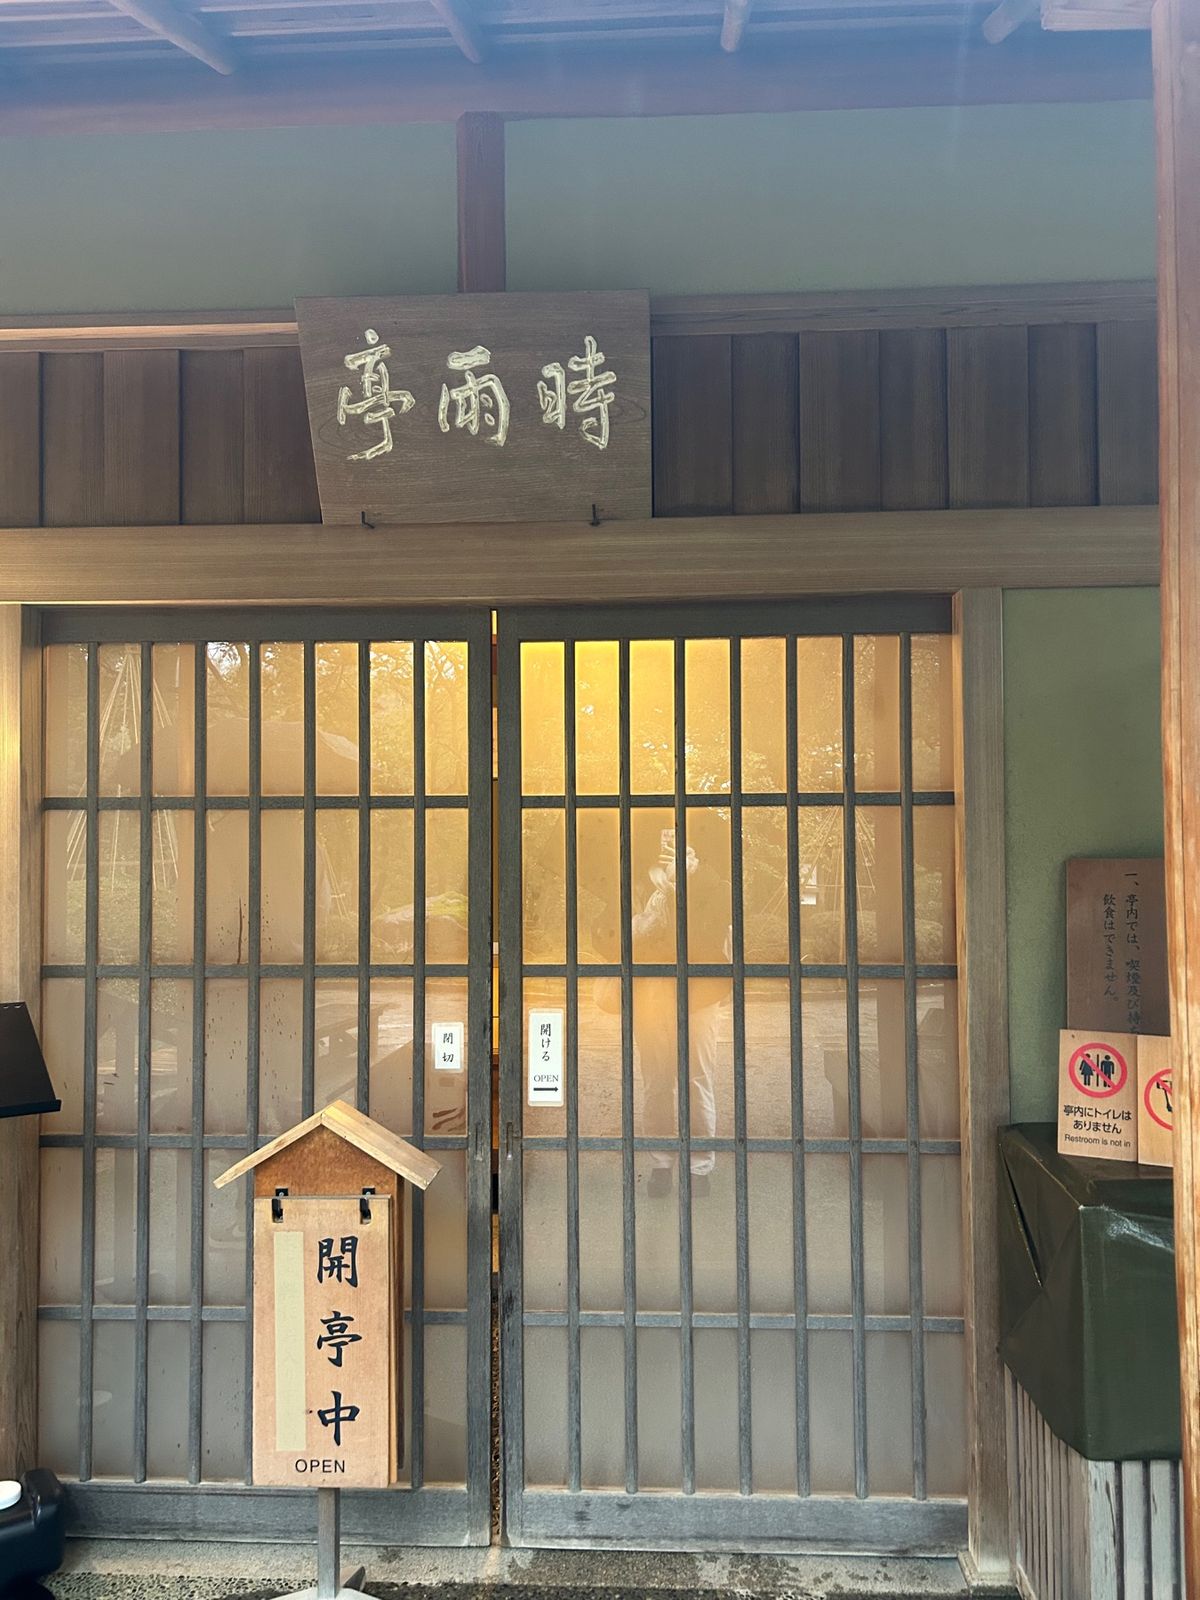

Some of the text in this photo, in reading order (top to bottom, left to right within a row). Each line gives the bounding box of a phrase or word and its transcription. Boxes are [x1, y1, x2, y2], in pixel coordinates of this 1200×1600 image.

[1103, 893, 1119, 1002] 飲食はできません。
[540, 1023, 552, 1062] 開ける
[533, 1073, 560, 1083] OPEN
[1063, 1104, 1132, 1121] 亭内にトイレは
[1073, 1119, 1122, 1135] ありません
[1064, 1133, 1131, 1148] Restroom is not in
[316, 1235, 362, 1446] 開亭中
[294, 1458, 346, 1474] OPEN
